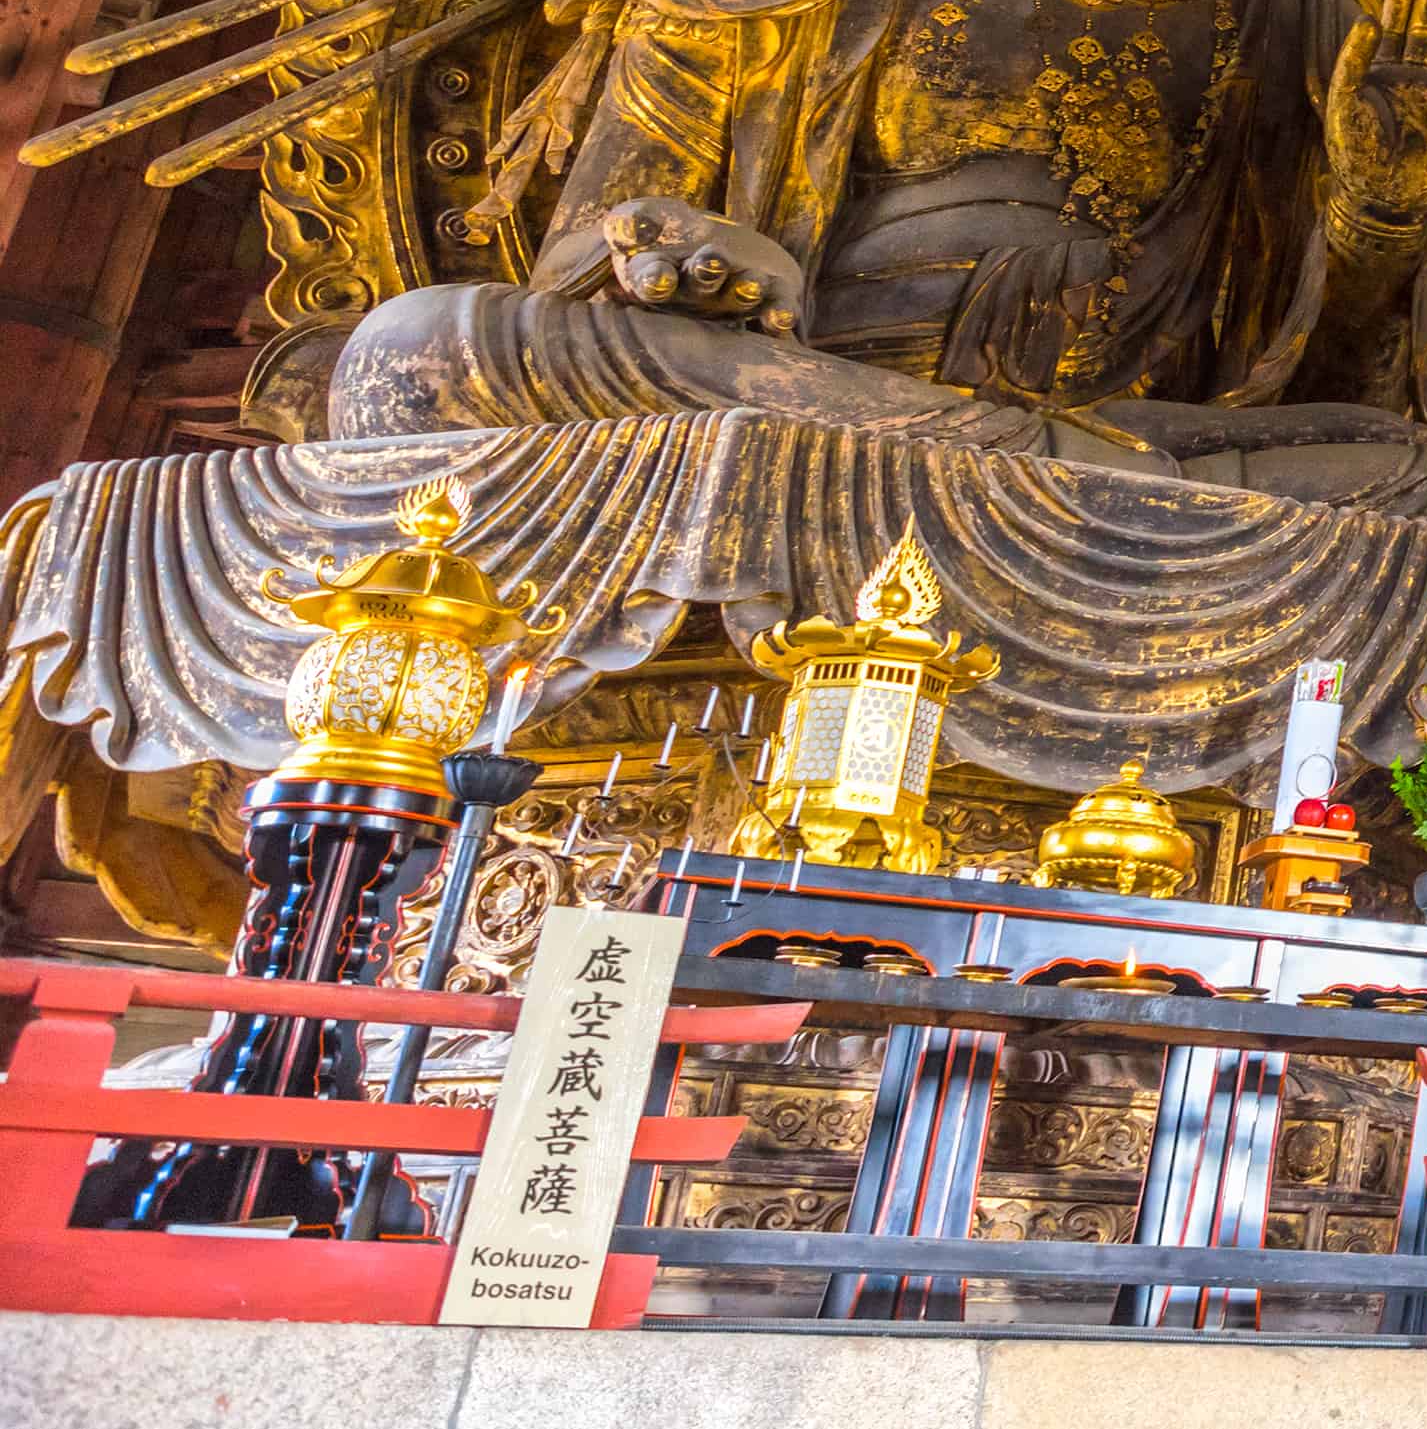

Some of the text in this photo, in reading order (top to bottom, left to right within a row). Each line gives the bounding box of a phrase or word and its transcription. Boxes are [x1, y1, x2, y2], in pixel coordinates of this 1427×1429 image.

[520, 936, 631, 1215] 虚空蔵菩薩
[471, 1247, 590, 1270] Kokuuzo-
[471, 1278, 573, 1301] bosatsu
